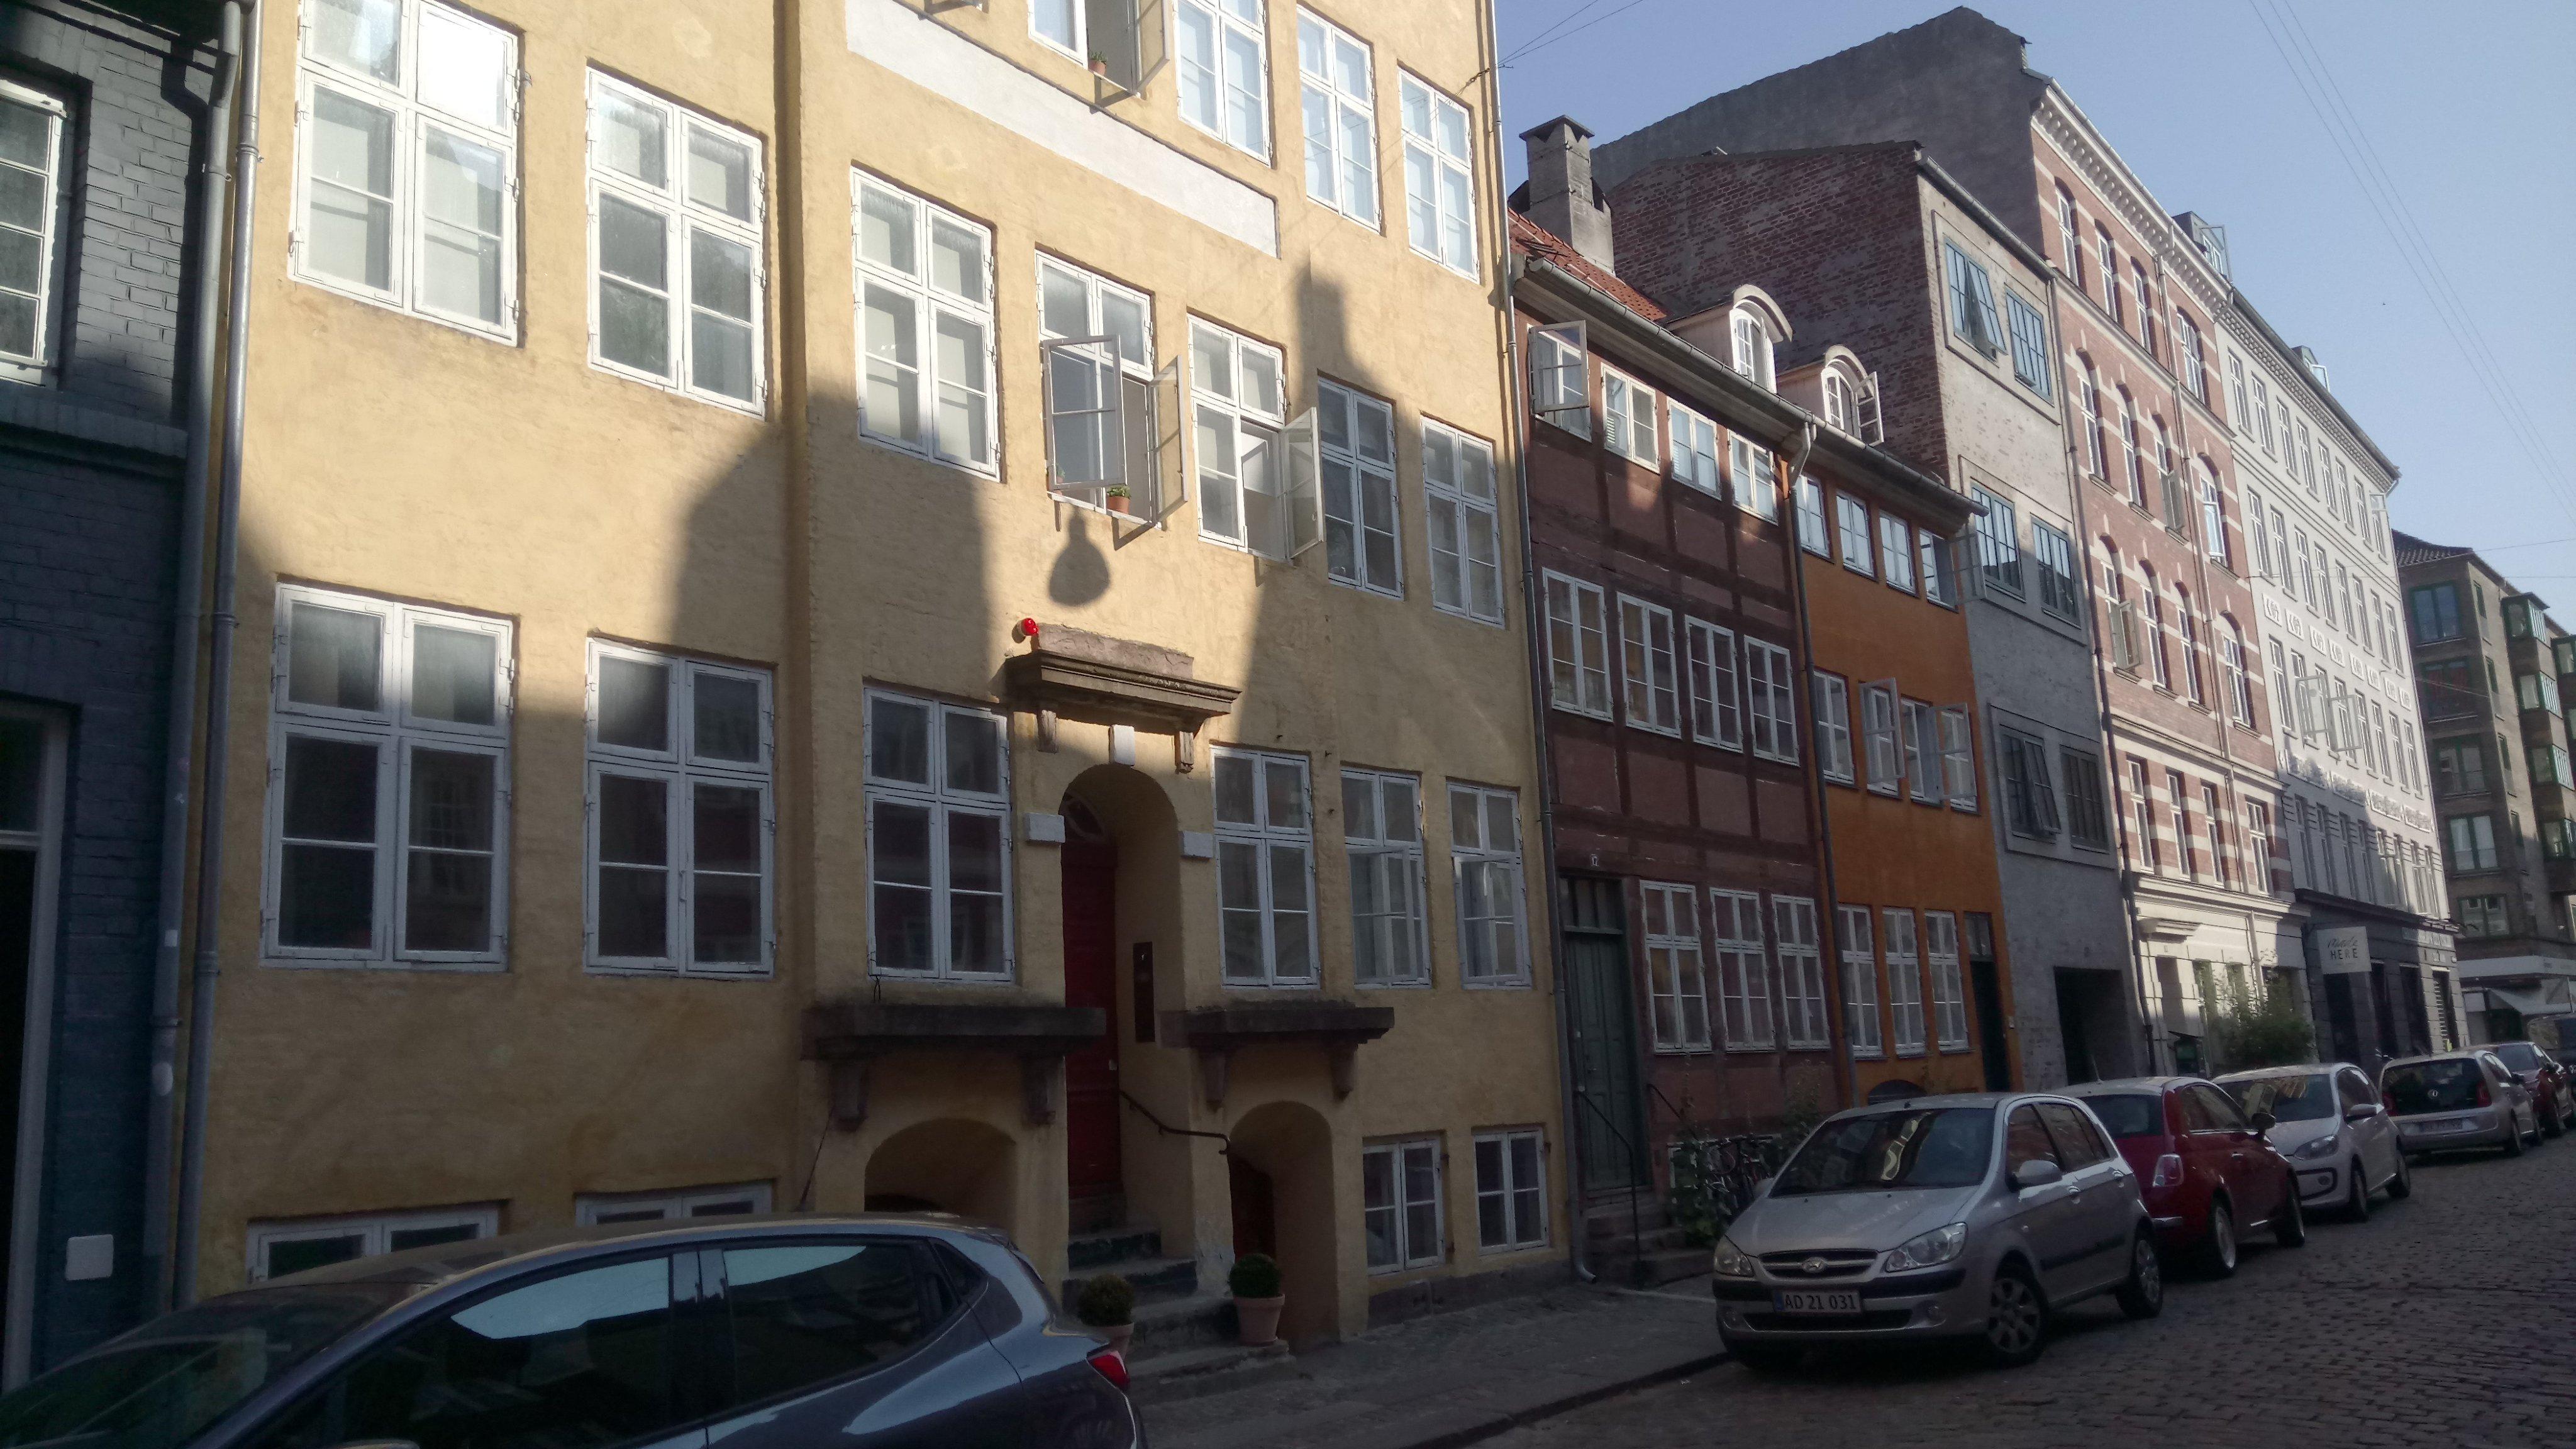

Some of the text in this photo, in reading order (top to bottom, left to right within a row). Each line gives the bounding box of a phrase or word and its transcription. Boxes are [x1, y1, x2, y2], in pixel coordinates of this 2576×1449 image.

[2330, 947, 2358, 960] HERE
[1785, 1294, 1856, 1310] AD 21 031
